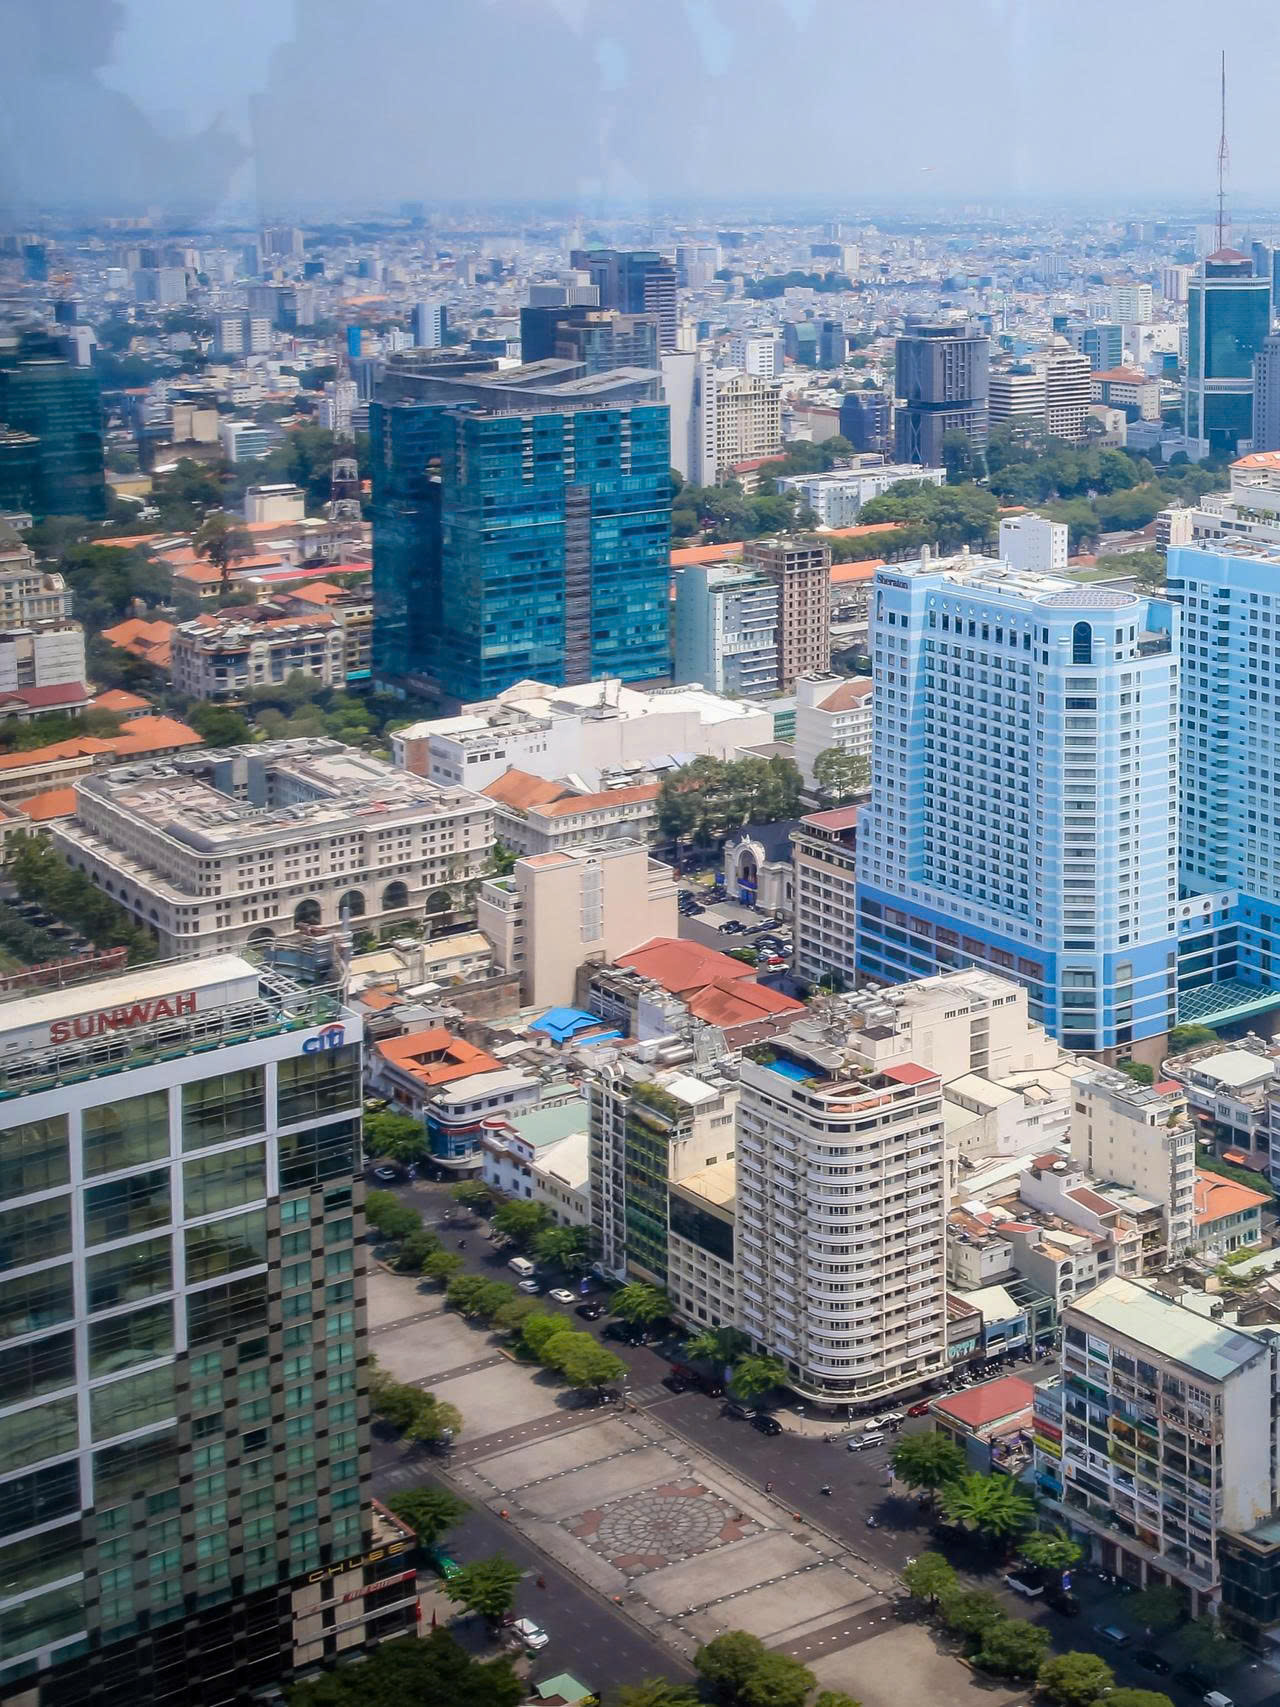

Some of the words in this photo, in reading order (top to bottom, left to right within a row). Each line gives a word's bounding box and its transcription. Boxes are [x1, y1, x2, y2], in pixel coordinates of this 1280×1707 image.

[877, 574, 908, 589] Sheraton
[50, 992, 197, 1044] SUNWAH
[303, 1025, 345, 1053] citi
[308, 1542, 407, 1583] CHUBB
